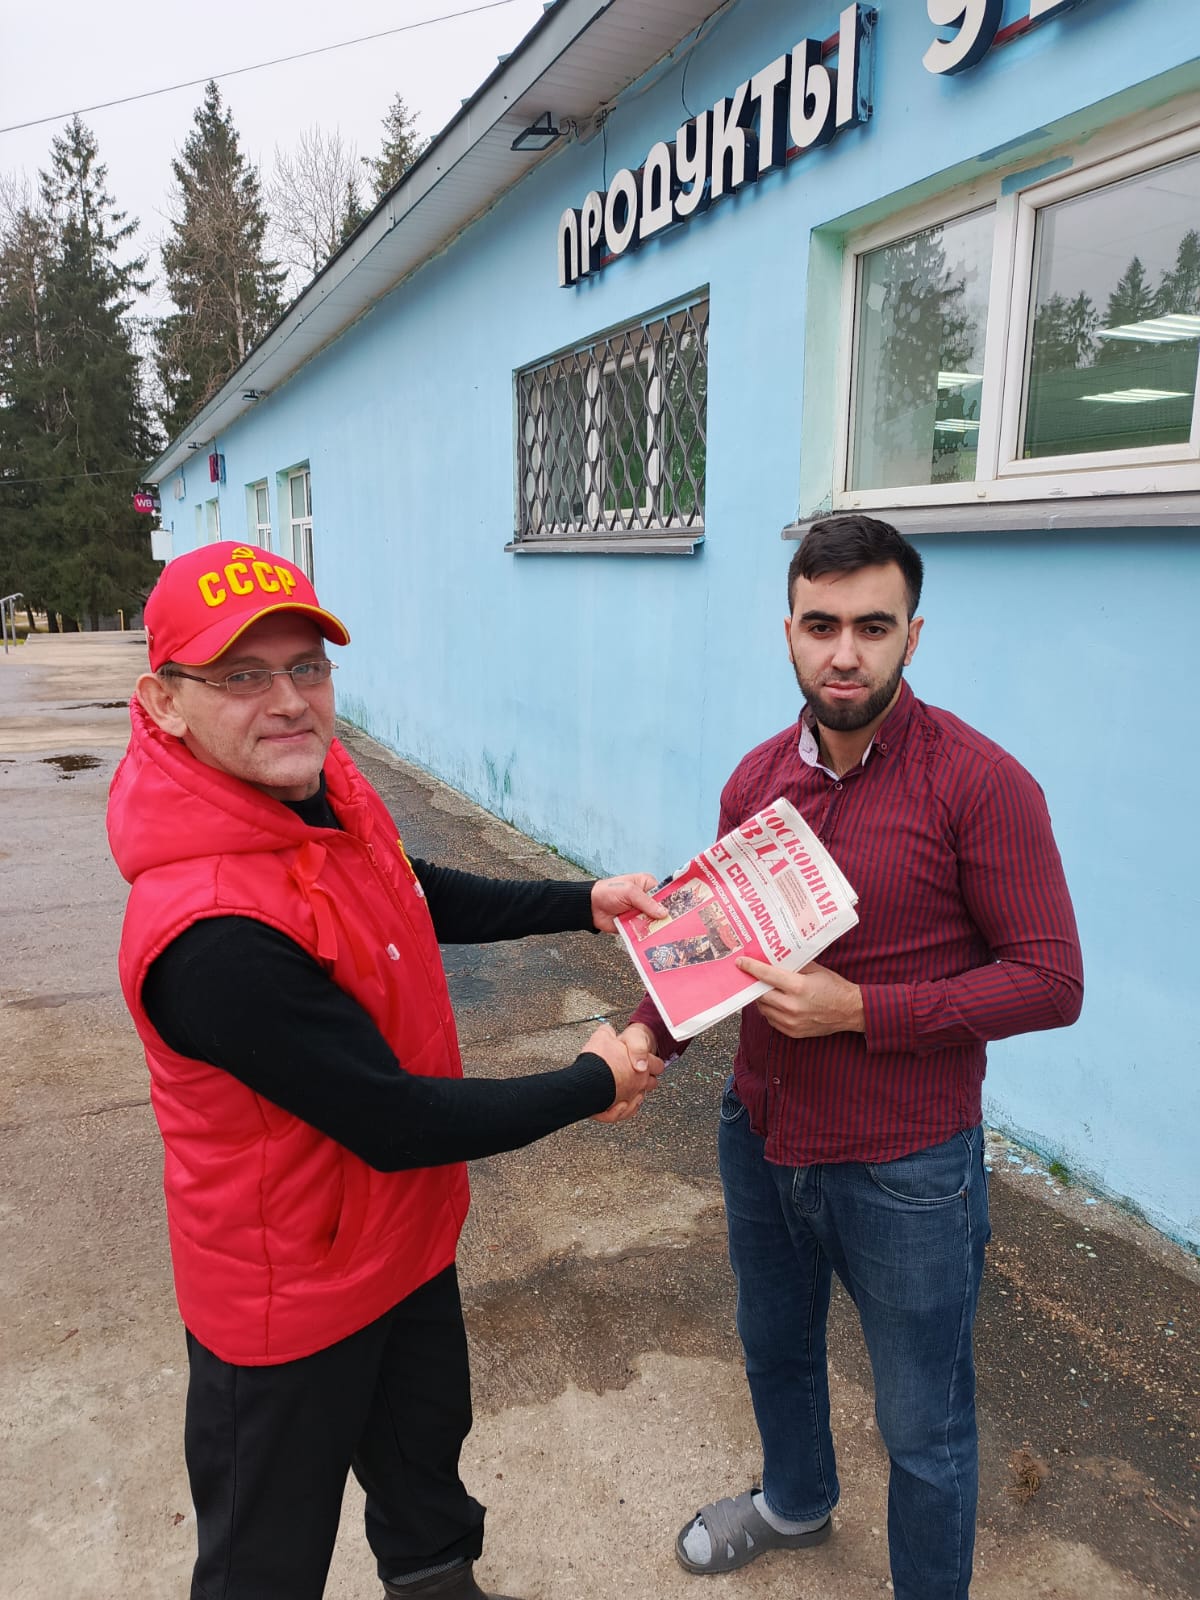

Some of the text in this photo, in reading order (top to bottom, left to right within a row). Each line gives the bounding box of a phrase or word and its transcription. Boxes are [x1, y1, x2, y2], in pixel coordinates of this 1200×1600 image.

[558, 2, 866, 288] ПРОДУКТЫ
[136, 498, 153, 508] WB
[198, 561, 297, 608] СССР
[726, 862, 792, 963] СОЦИАЛИЗМ!
